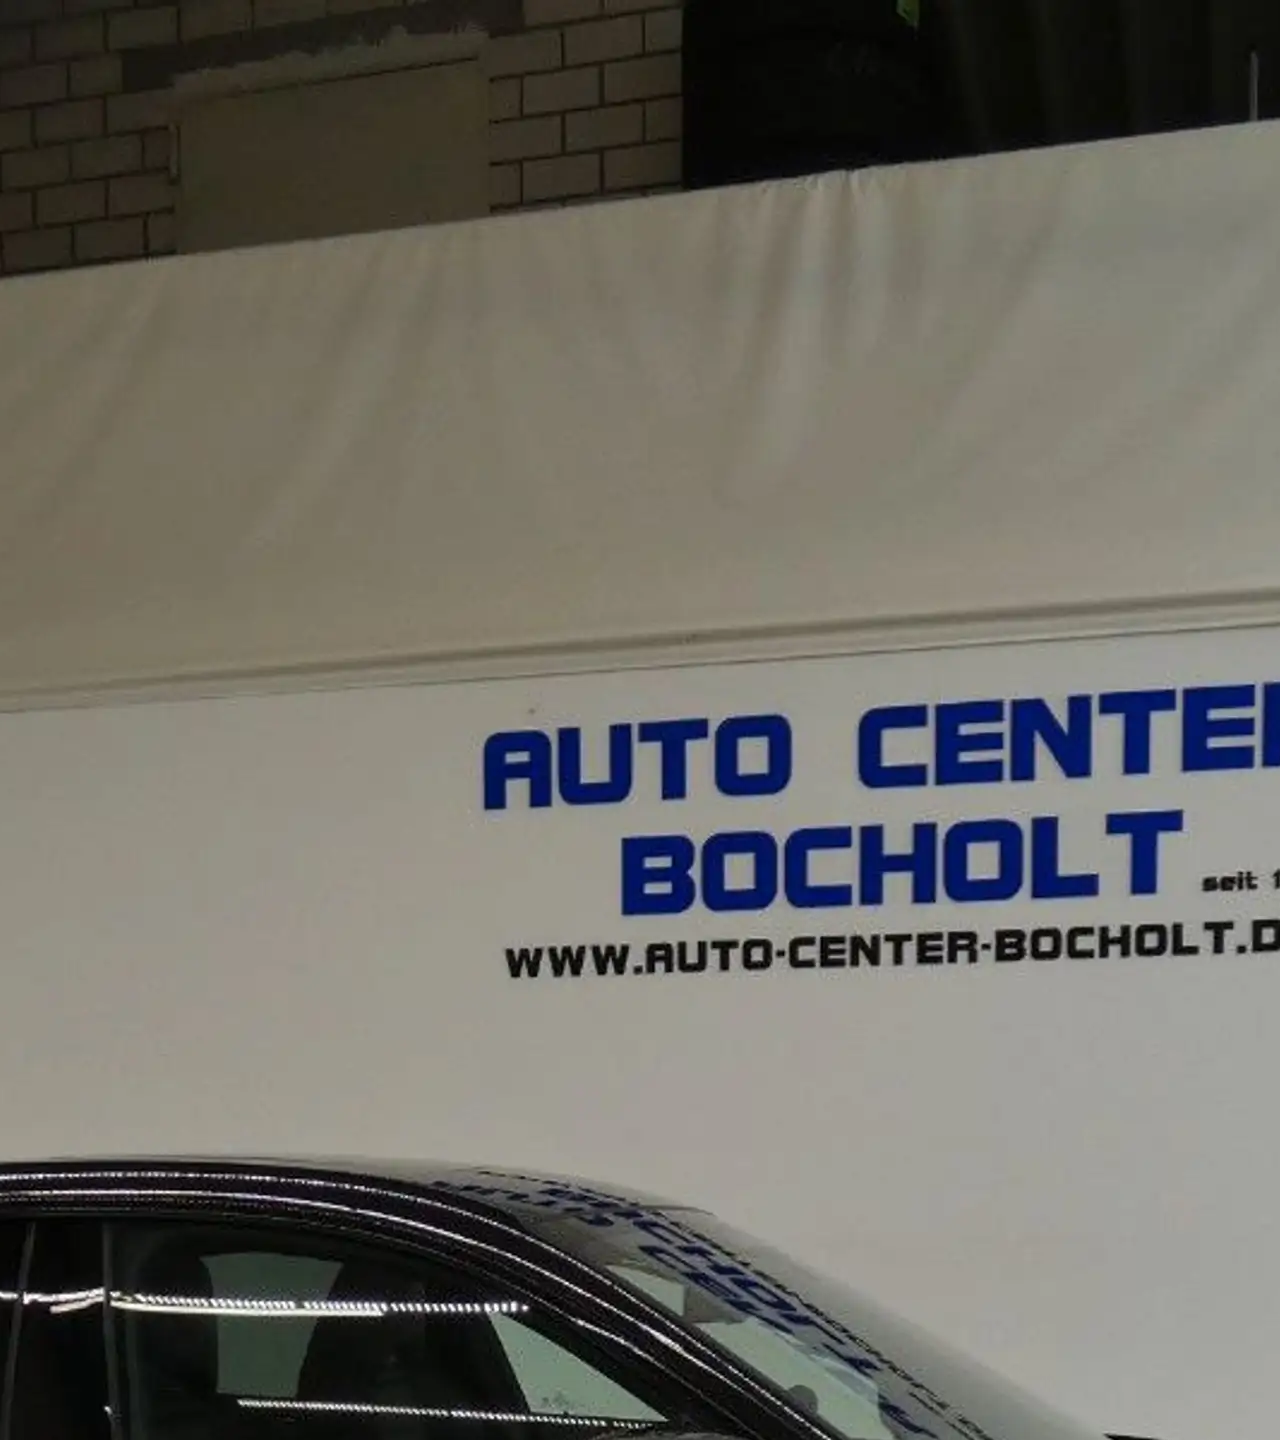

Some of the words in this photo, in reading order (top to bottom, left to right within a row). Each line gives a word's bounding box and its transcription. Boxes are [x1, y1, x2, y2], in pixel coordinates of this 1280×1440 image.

[483, 714, 793, 809] AUTO
[620, 810, 1185, 916] BOCHOLT
[1201, 871, 1259, 893] seit
